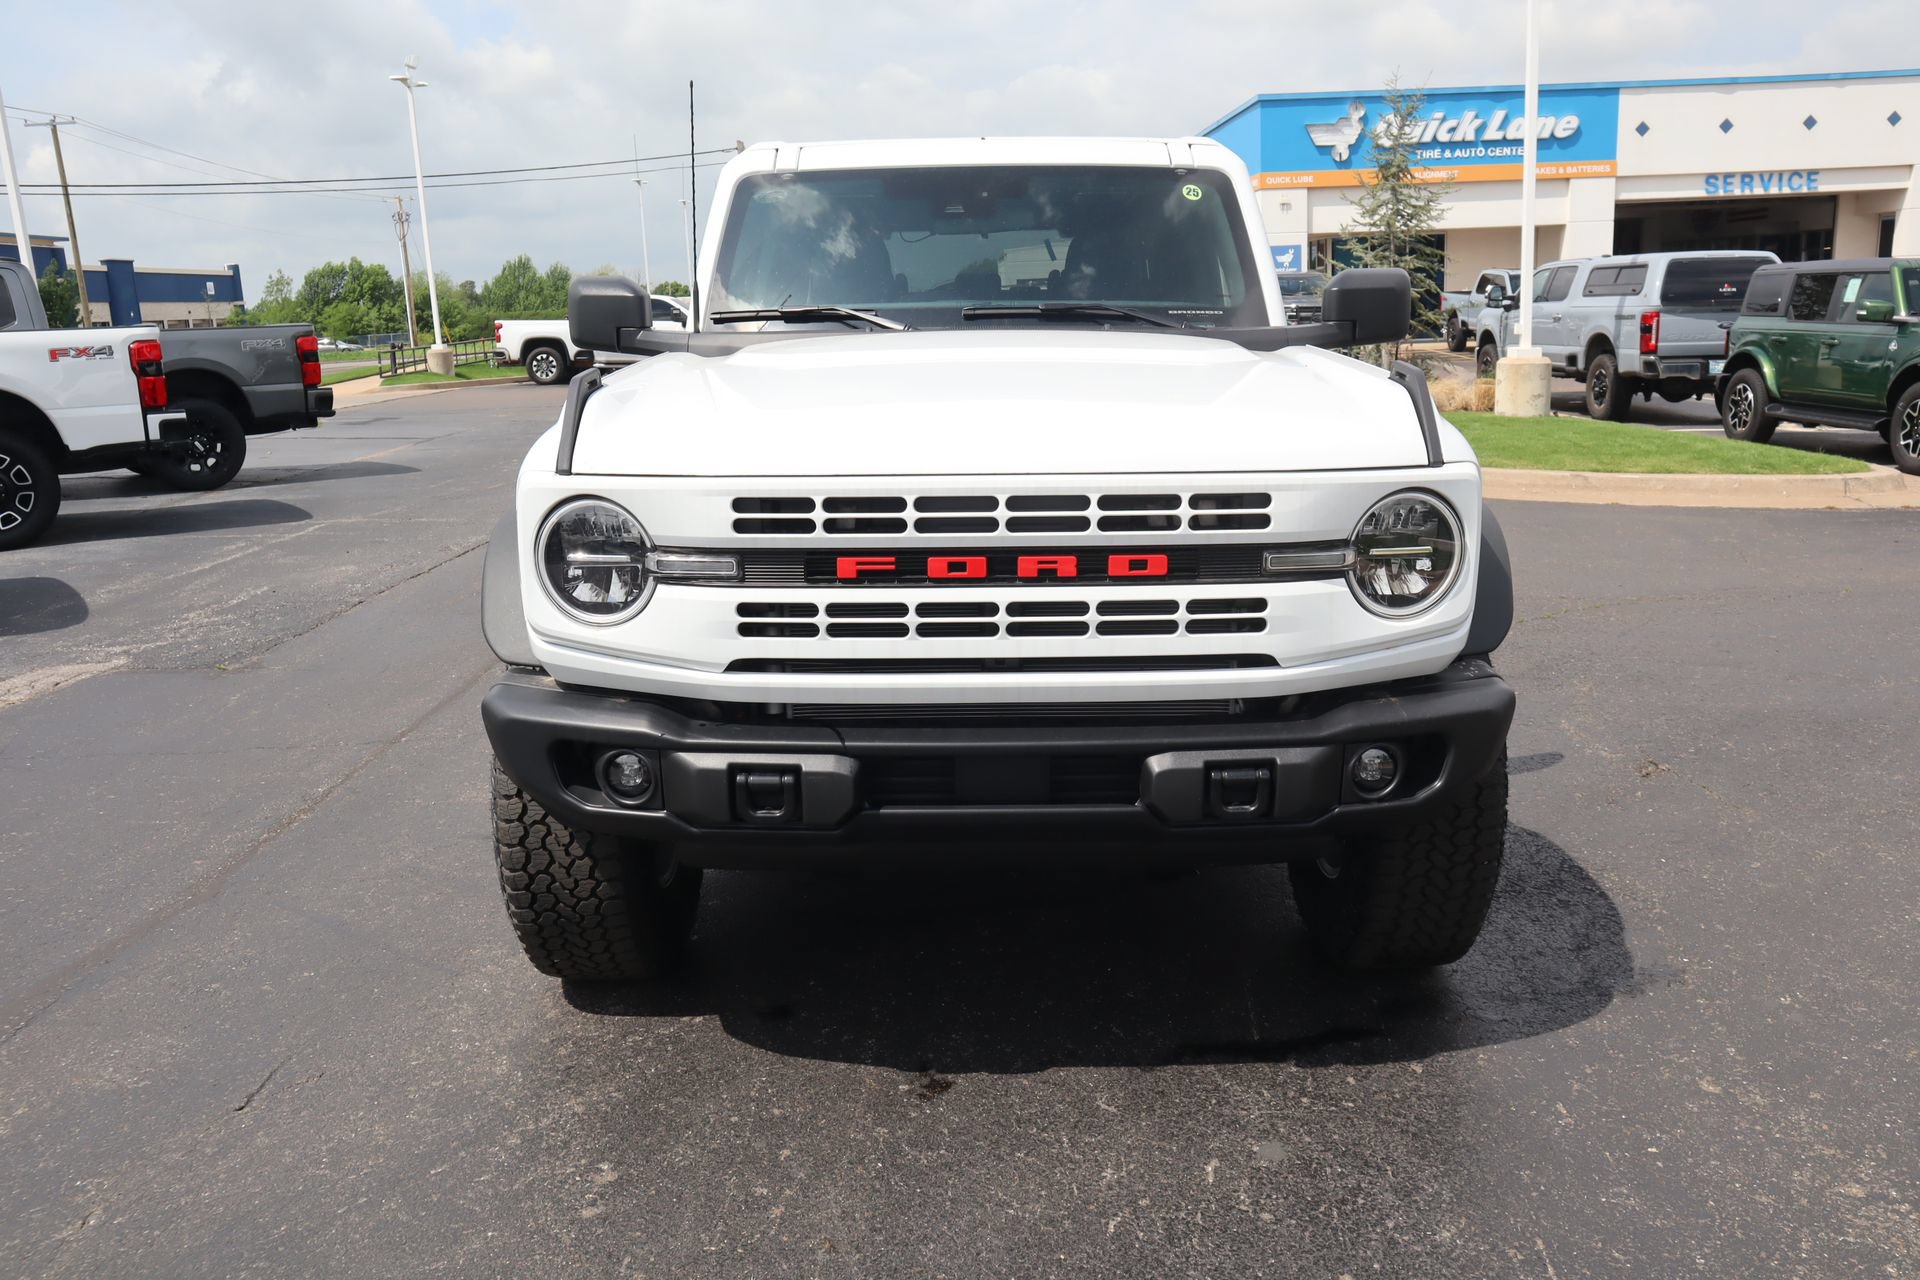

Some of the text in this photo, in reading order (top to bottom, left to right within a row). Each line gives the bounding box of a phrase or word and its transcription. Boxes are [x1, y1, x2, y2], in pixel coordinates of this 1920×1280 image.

[1374, 107, 1580, 148] Quick Lane
[1416, 145, 1525, 160] TIRE & AUTO CENTE
[1536, 166, 1557, 174] AKES
[1566, 164, 1611, 173] BATTERIES
[1266, 176, 1292, 184] QUICK
[1293, 176, 1314, 184] LUBE
[1704, 171, 1820, 195] SERVICE
[1185, 186, 1200, 198] 25
[241, 338, 286, 351] FX4
[48, 345, 114, 362] FX4
[836, 555, 1168, 579] FORD
